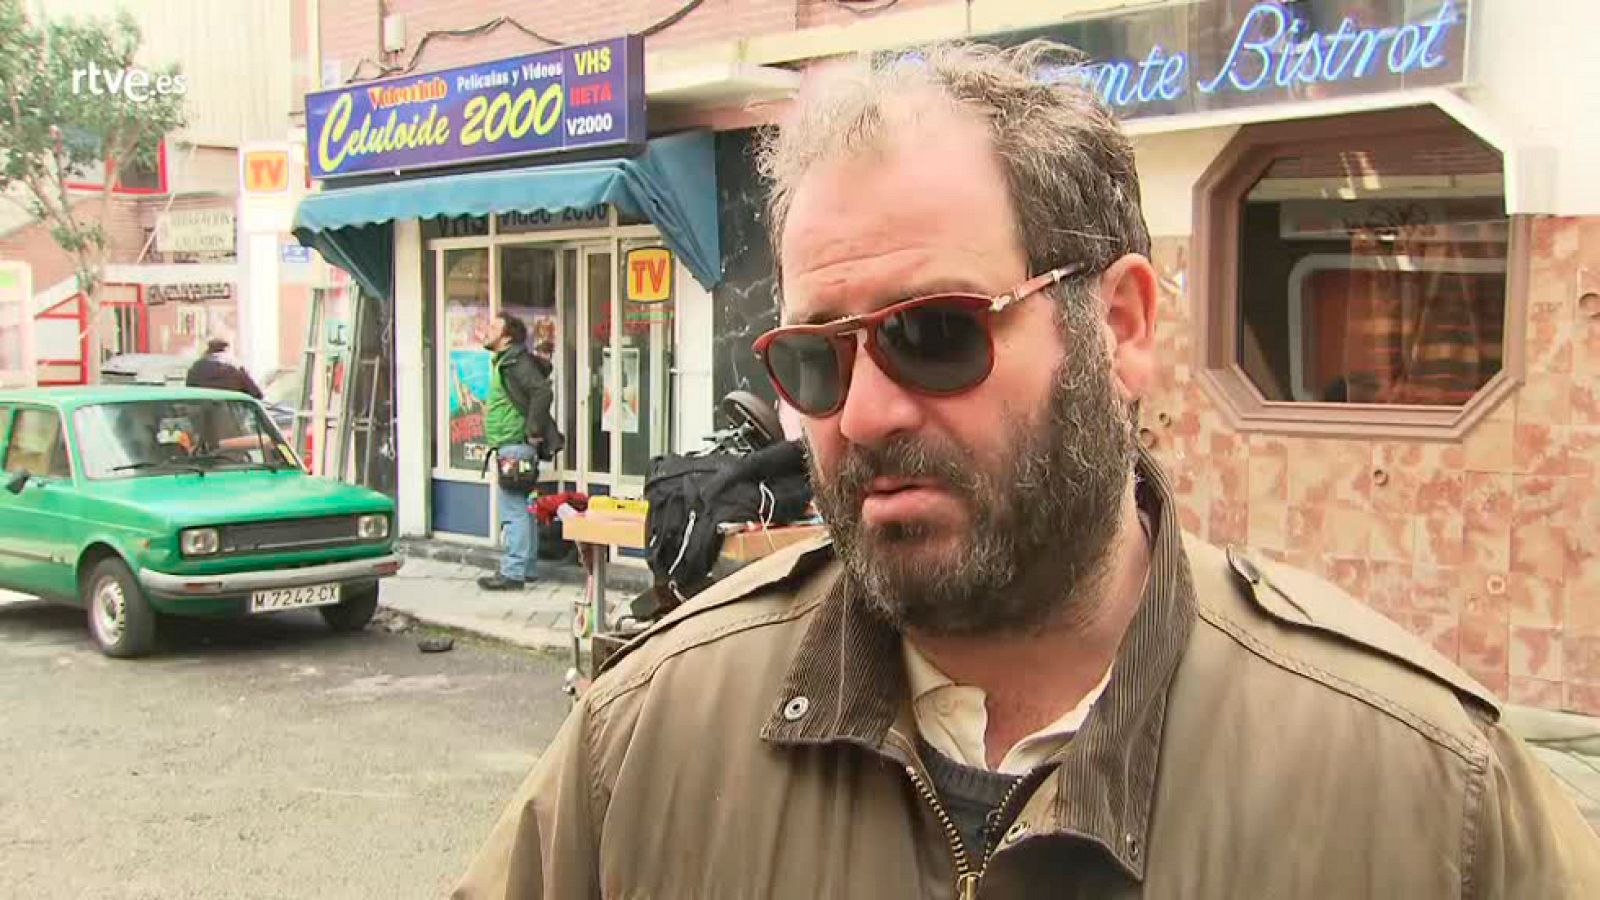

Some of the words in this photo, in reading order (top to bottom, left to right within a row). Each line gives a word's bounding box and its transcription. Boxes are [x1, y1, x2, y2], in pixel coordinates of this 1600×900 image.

[1197, 0, 1459, 93] Bistrot
[512, 68, 519, 86] y
[522, 62, 563, 80] Videos
[574, 47, 612, 75] VHS
[318, 92, 450, 171] Celuloide
[460, 83, 563, 145] 2000
[567, 113, 612, 136] V2000
[250, 159, 285, 186] TV
[631, 257, 666, 293] TV
